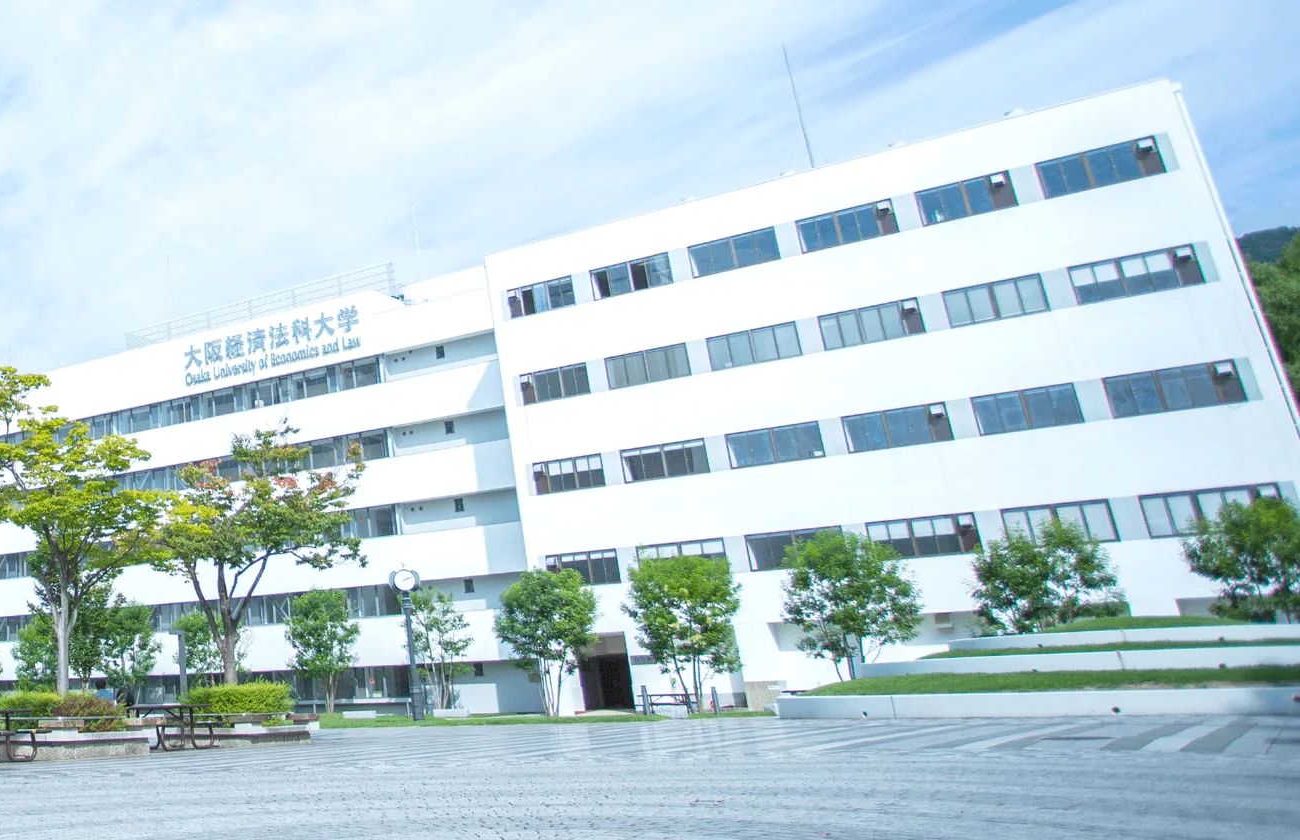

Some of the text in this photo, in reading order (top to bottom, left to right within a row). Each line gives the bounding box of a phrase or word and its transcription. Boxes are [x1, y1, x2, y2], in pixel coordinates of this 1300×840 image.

[184, 305, 359, 370] 大阪経済法科大学
[185, 337, 361, 387] Osaka University of Economics and Law
